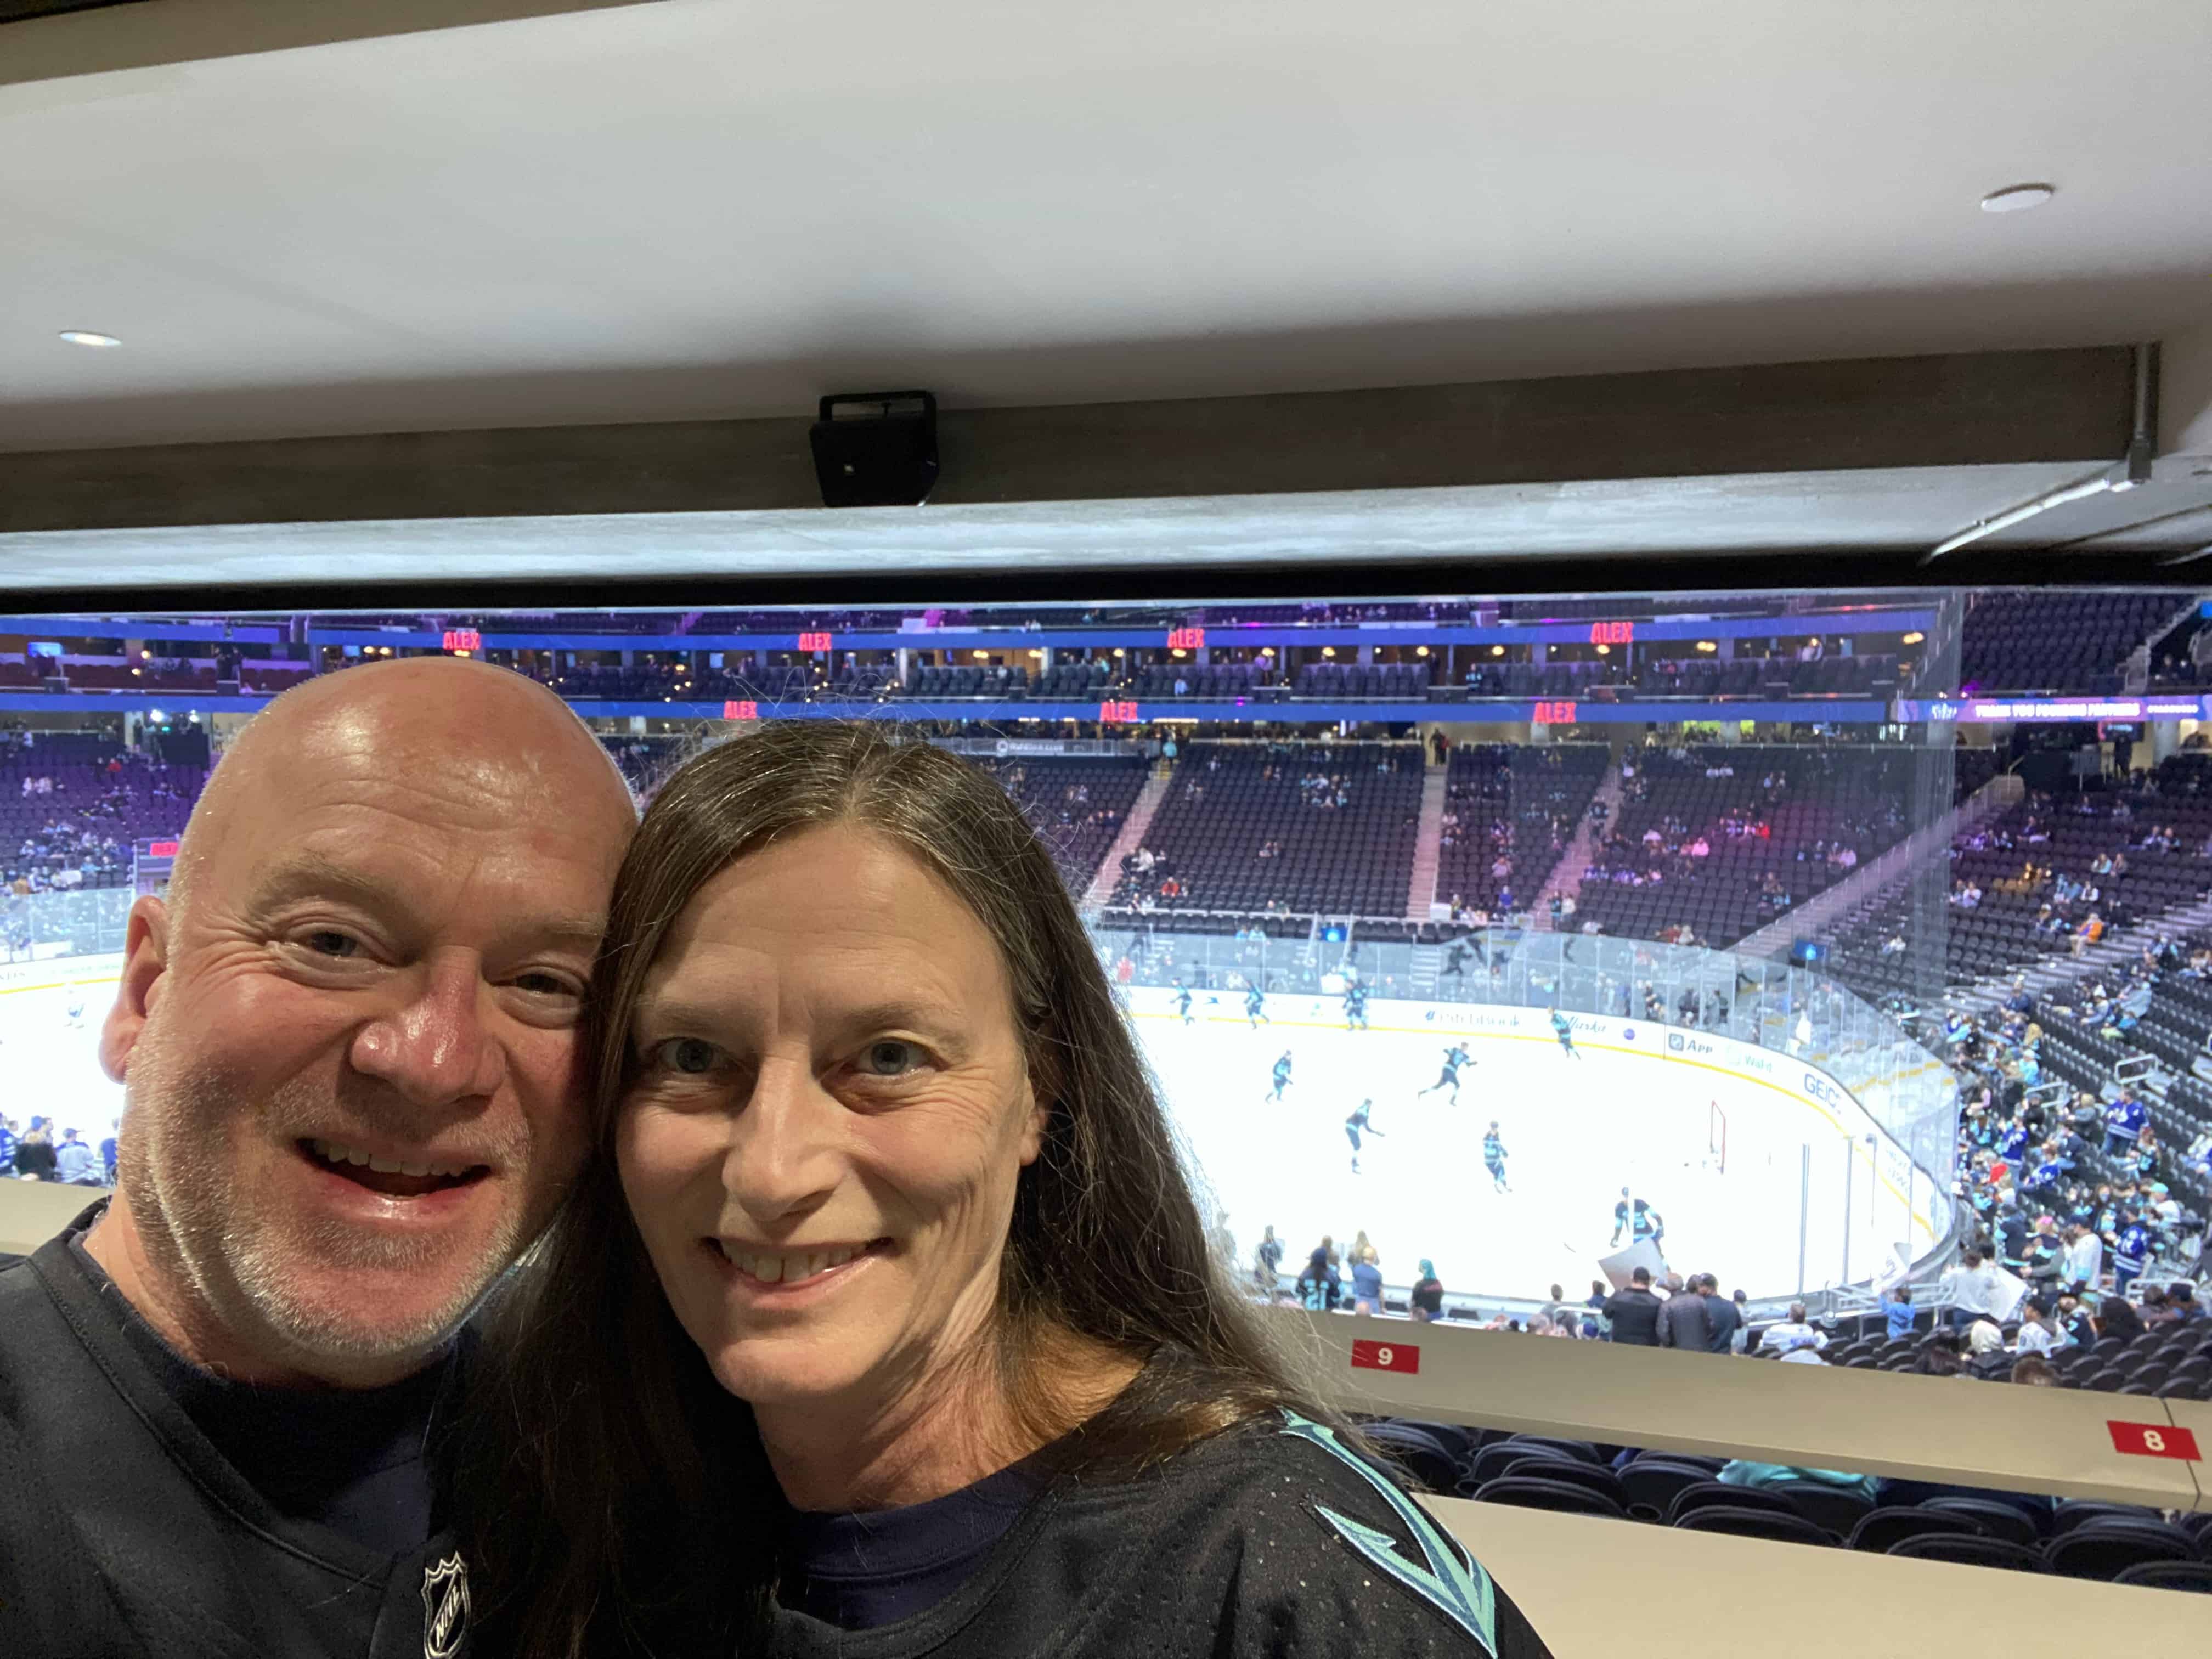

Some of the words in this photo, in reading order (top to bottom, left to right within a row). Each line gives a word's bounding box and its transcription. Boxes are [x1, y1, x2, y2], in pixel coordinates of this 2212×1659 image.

[443, 631, 480, 653] ALEX
[799, 633, 831, 651] ALEX
[1167, 628, 1204, 651] ALEX
[1591, 622, 1633, 644] ALEX
[724, 701, 757, 720] ALEX
[1101, 702, 1137, 722] ALEX
[1533, 702, 1576, 724] ALEX
[1378, 1347, 1393, 1365] 9
[2142, 1429, 2166, 1452] 8
[435, 1583, 461, 1649] NHL
